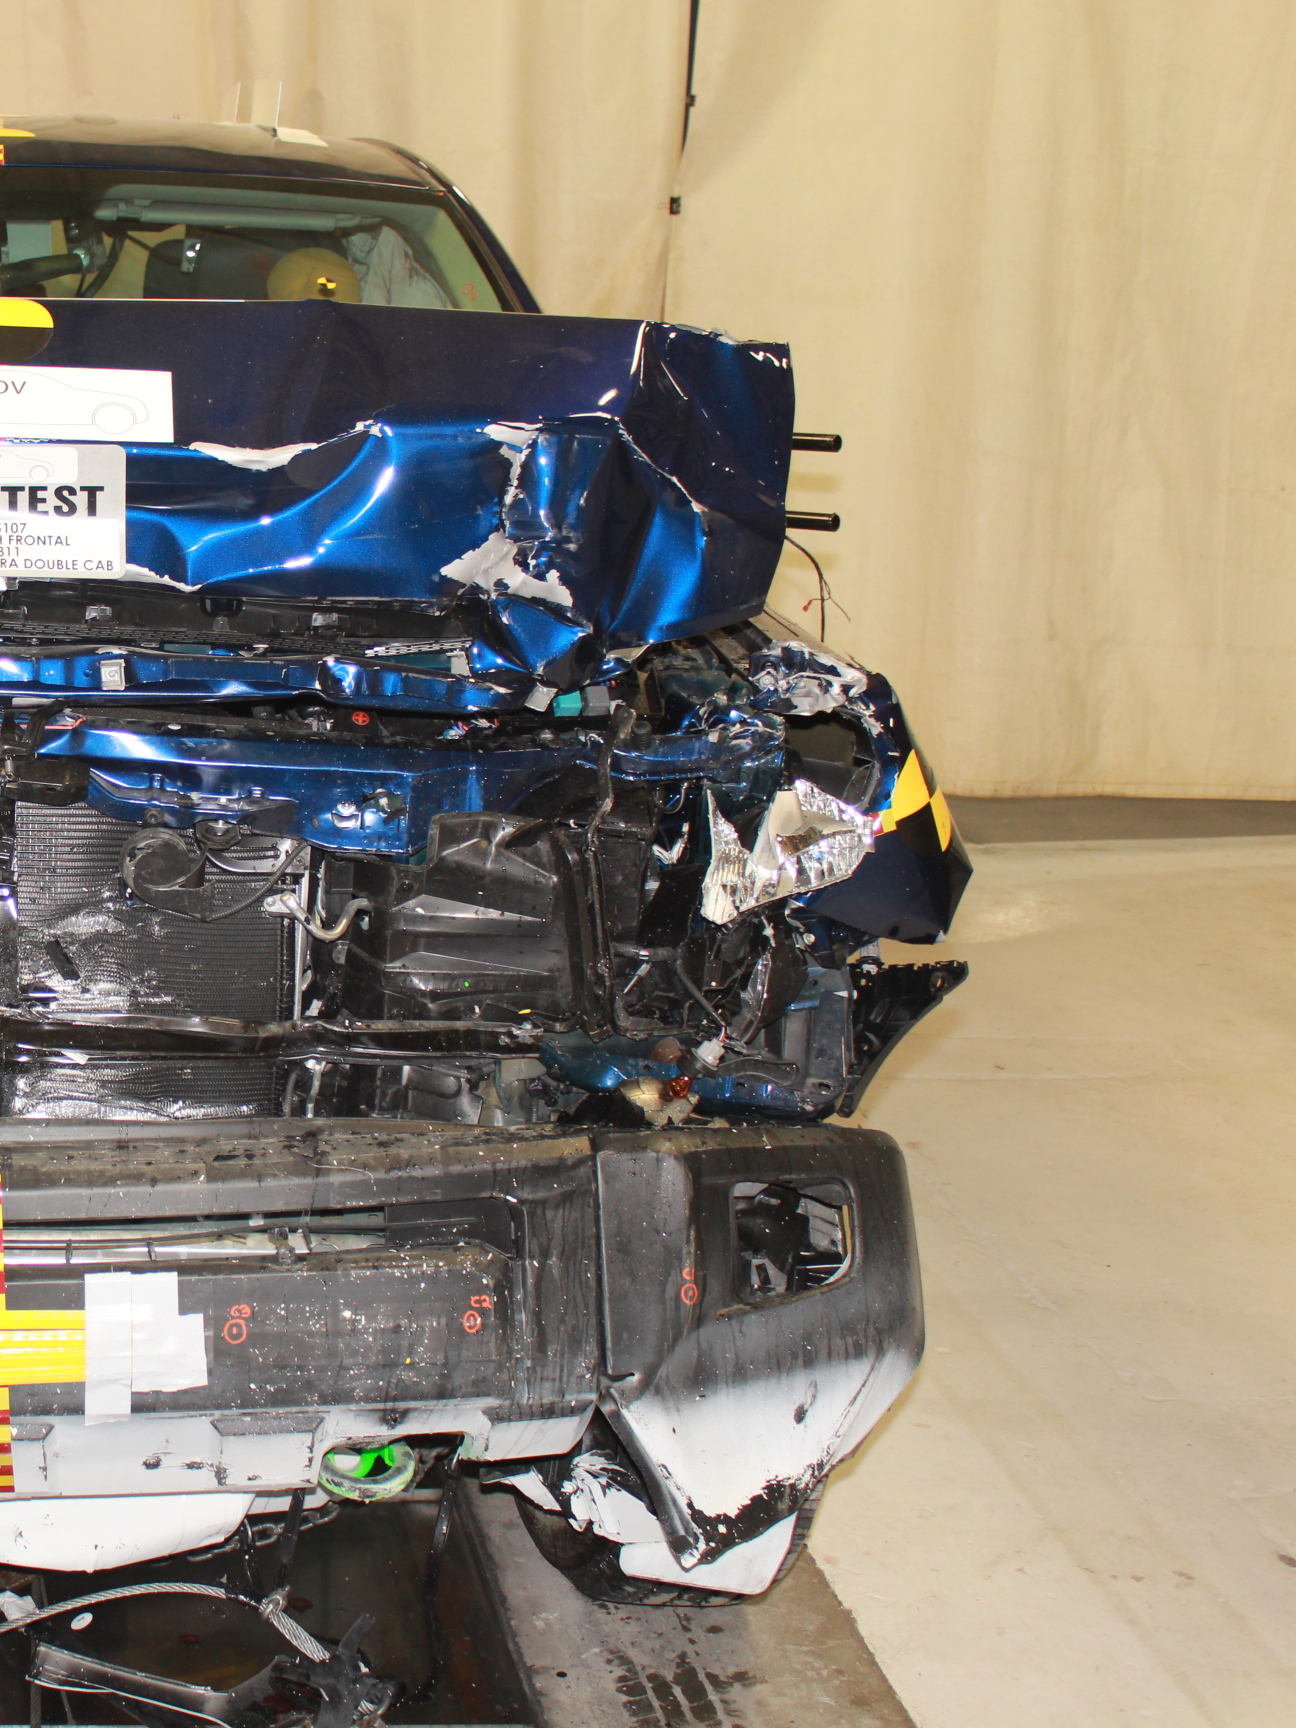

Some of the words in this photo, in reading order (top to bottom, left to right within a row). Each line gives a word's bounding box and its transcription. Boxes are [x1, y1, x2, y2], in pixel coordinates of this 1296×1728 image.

[8, 535, 71, 547] FRONTAL
[24, 558, 79, 571] DOUBLE
[83, 559, 115, 572] CAB
[470, 1294, 493, 1309] C2
[230, 1303, 251, 1318] C3
